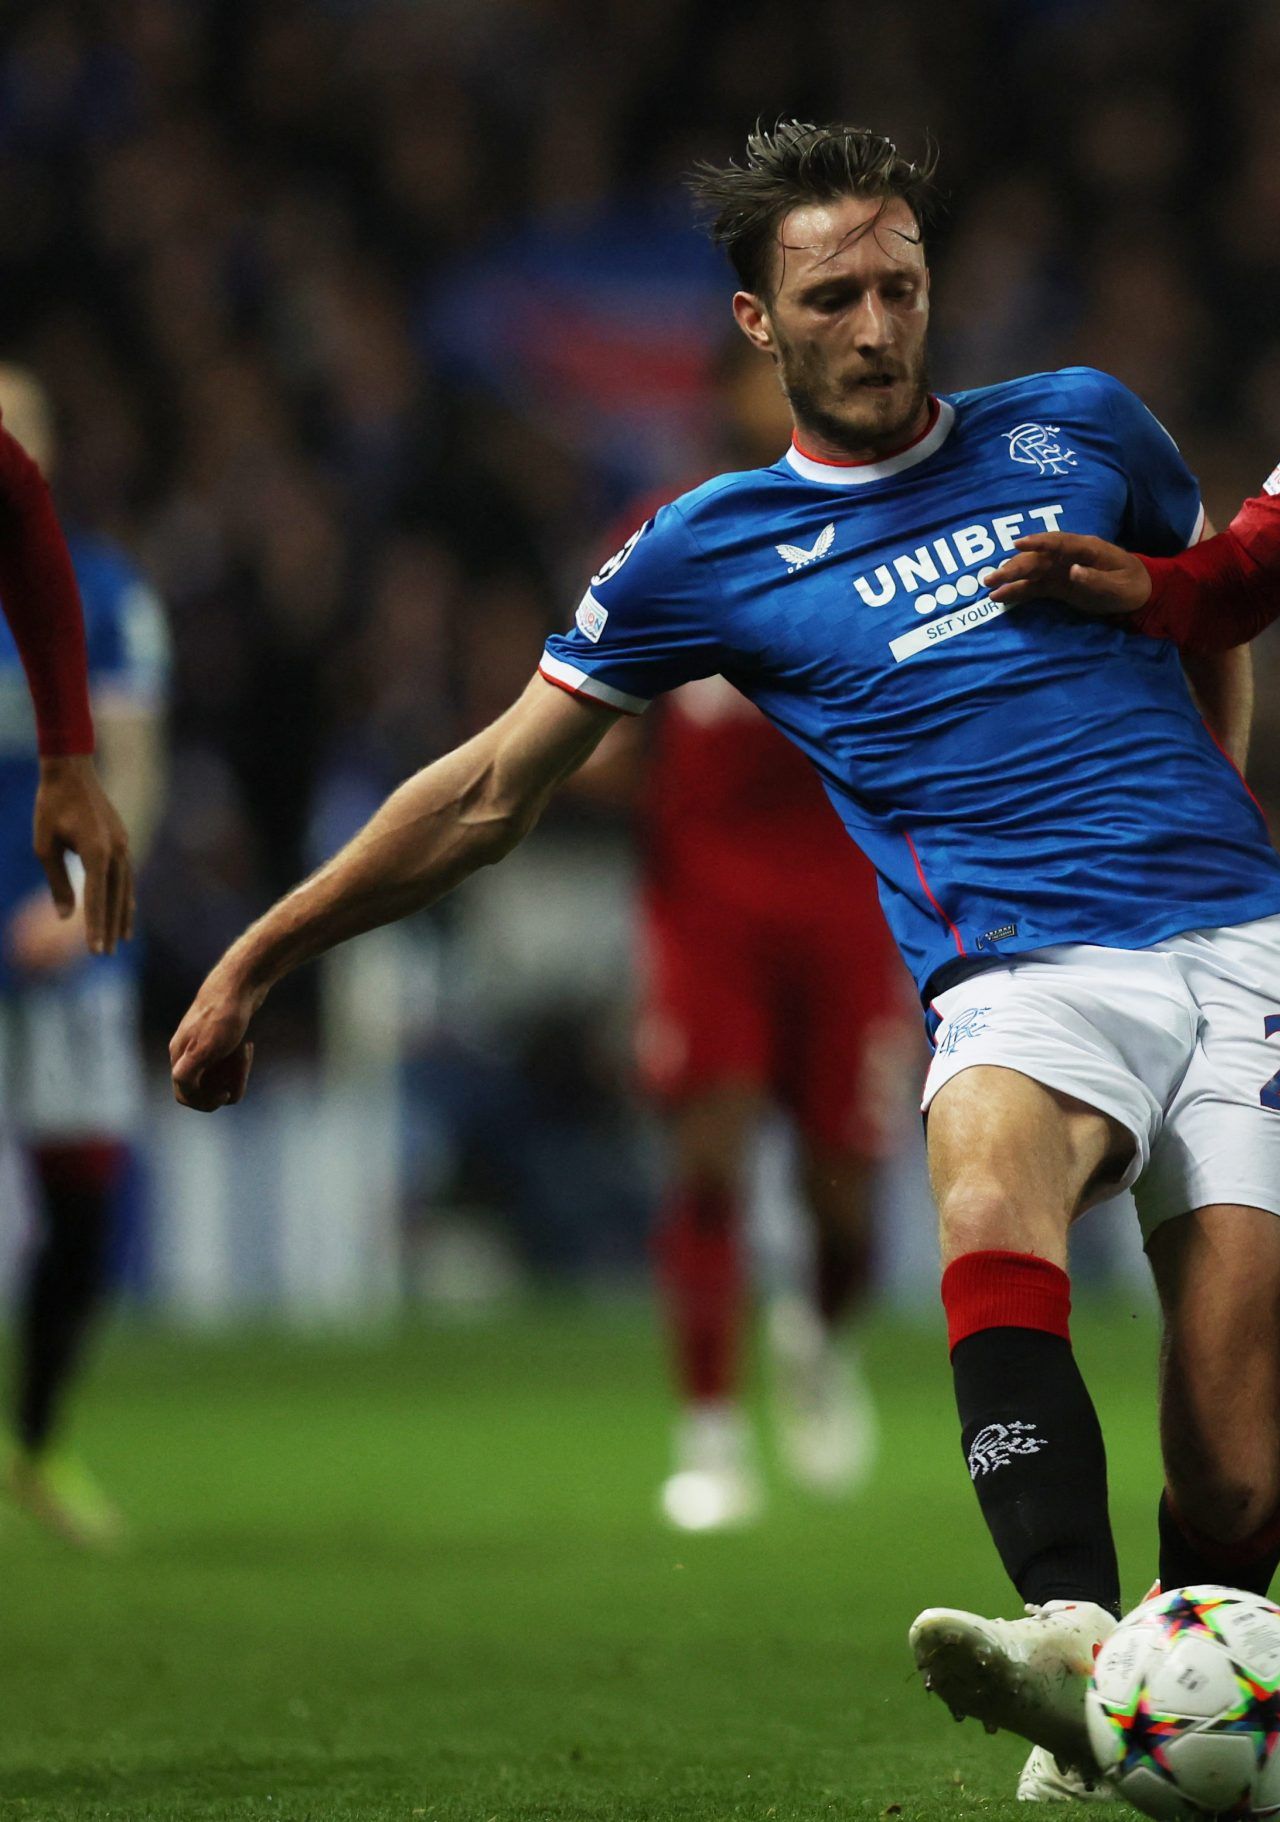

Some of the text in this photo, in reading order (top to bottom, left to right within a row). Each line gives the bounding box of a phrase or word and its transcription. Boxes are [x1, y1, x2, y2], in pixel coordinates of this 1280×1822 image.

[853, 504, 1063, 607] UNIBET
[926, 619, 954, 640] SET
[956, 600, 999, 626] YOUR
